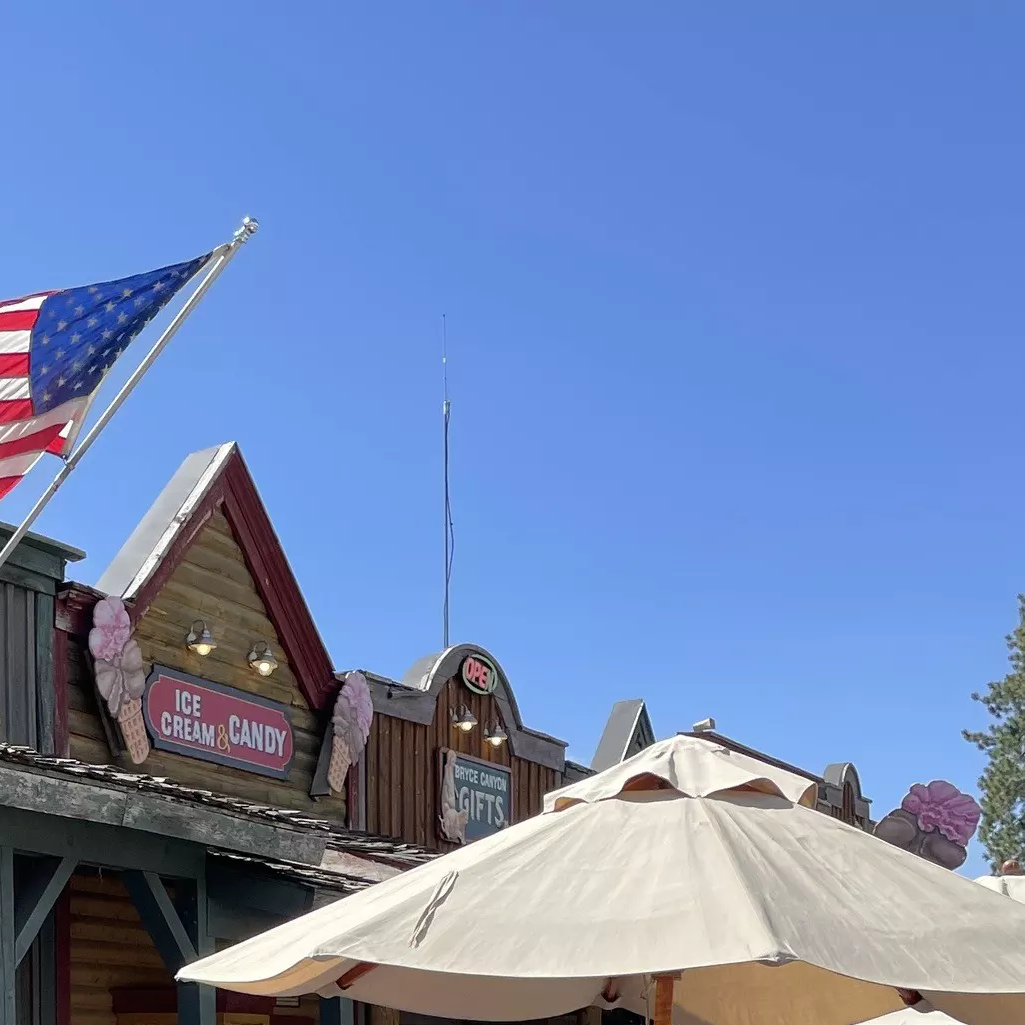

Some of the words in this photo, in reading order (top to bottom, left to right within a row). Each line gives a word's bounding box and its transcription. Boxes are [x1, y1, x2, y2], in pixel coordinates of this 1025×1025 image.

[175, 689, 201, 718] ICE
[161, 711, 215, 747] CREAM
[217, 724, 230, 753] &
[228, 714, 287, 757] CANDY
[455, 765, 478, 784] BRYCE
[480, 771, 507, 792] CANYON
[459, 786, 505, 828] GIFTS
